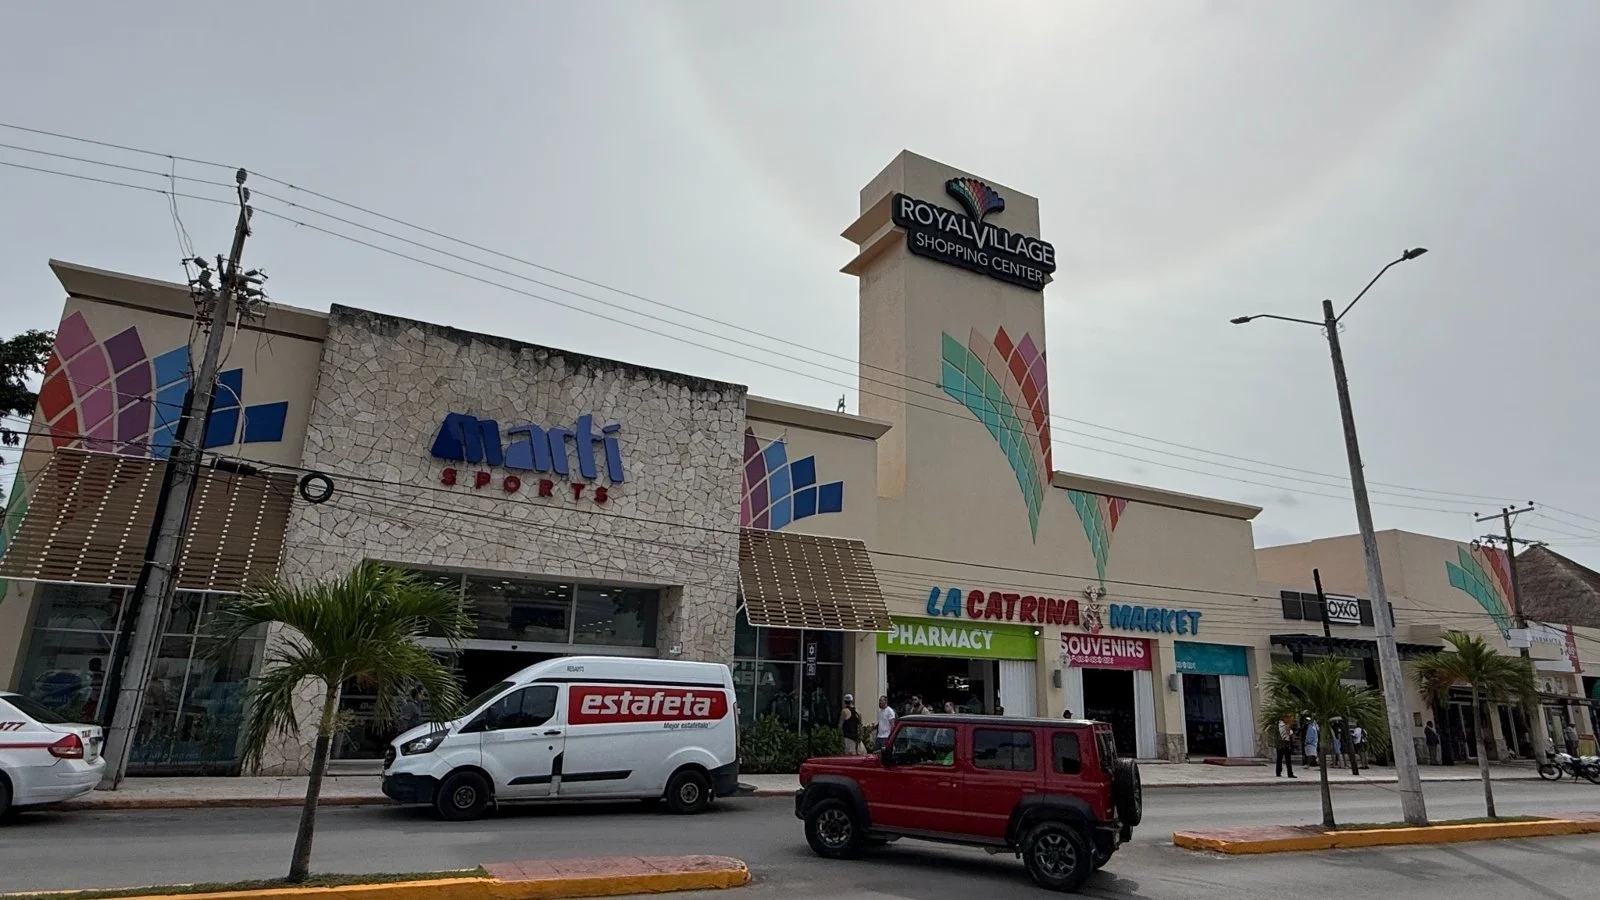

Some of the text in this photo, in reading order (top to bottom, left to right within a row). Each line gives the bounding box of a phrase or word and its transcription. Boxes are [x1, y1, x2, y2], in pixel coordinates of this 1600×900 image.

[900, 198, 1054, 265] ROYALVILLAGE
[916, 232, 1043, 283] SHOPPING CENTER
[441, 468, 609, 503] SPORTS
[926, 586, 1202, 635] LA CATRINA MARKET
[1328, 600, 1358, 618] OXXO
[887, 623, 993, 650] PHARMACY
[1060, 635, 1144, 659] SOUVENIRS
[580, 691, 711, 716] estafeta
